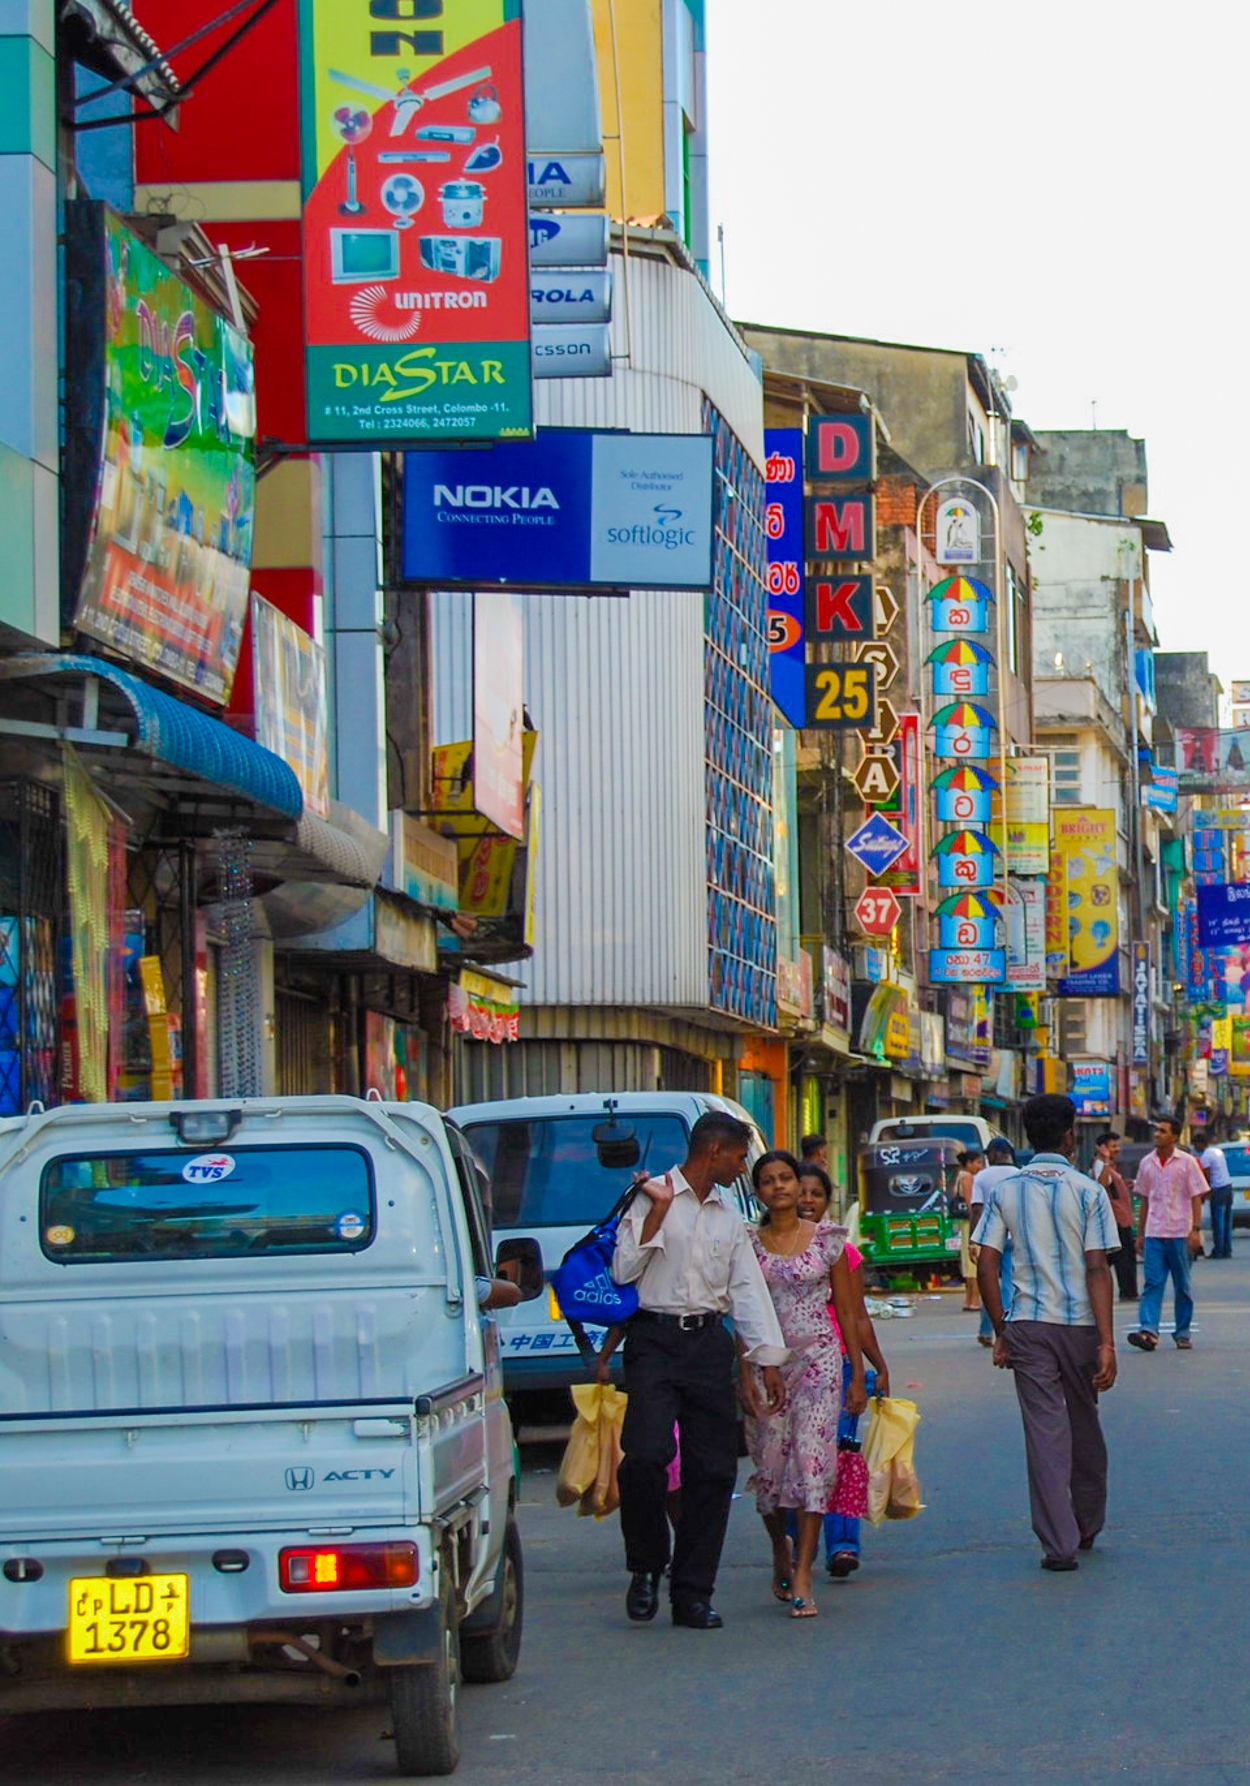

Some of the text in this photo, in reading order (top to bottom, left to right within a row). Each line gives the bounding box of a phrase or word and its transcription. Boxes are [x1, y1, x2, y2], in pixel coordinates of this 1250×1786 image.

[325, 405, 331, 416] #
[334, 405, 350, 417] 11,
[353, 404, 372, 415] 2nd
[374, 404, 403, 415] Cross
[406, 404, 441, 416] Street,
[444, 403, 487, 414] Colombo
[358, 418, 375, 430] Tel
[433, 417, 476, 429] 2472057
[433, 484, 560, 509] NOKIA
[437, 511, 555, 525] CONNECTING PEOPLE
[608, 524, 696, 550] softlogic
[815, 669, 869, 720] 25
[1060, 823, 1106, 834] BRIGHT
[861, 898, 890, 923] 37
[188, 1163, 225, 1181] TVS
[322, 1468, 397, 1482] ACTY
[110, 1581, 154, 1615] LD
[84, 1618, 171, 1654] 1378
